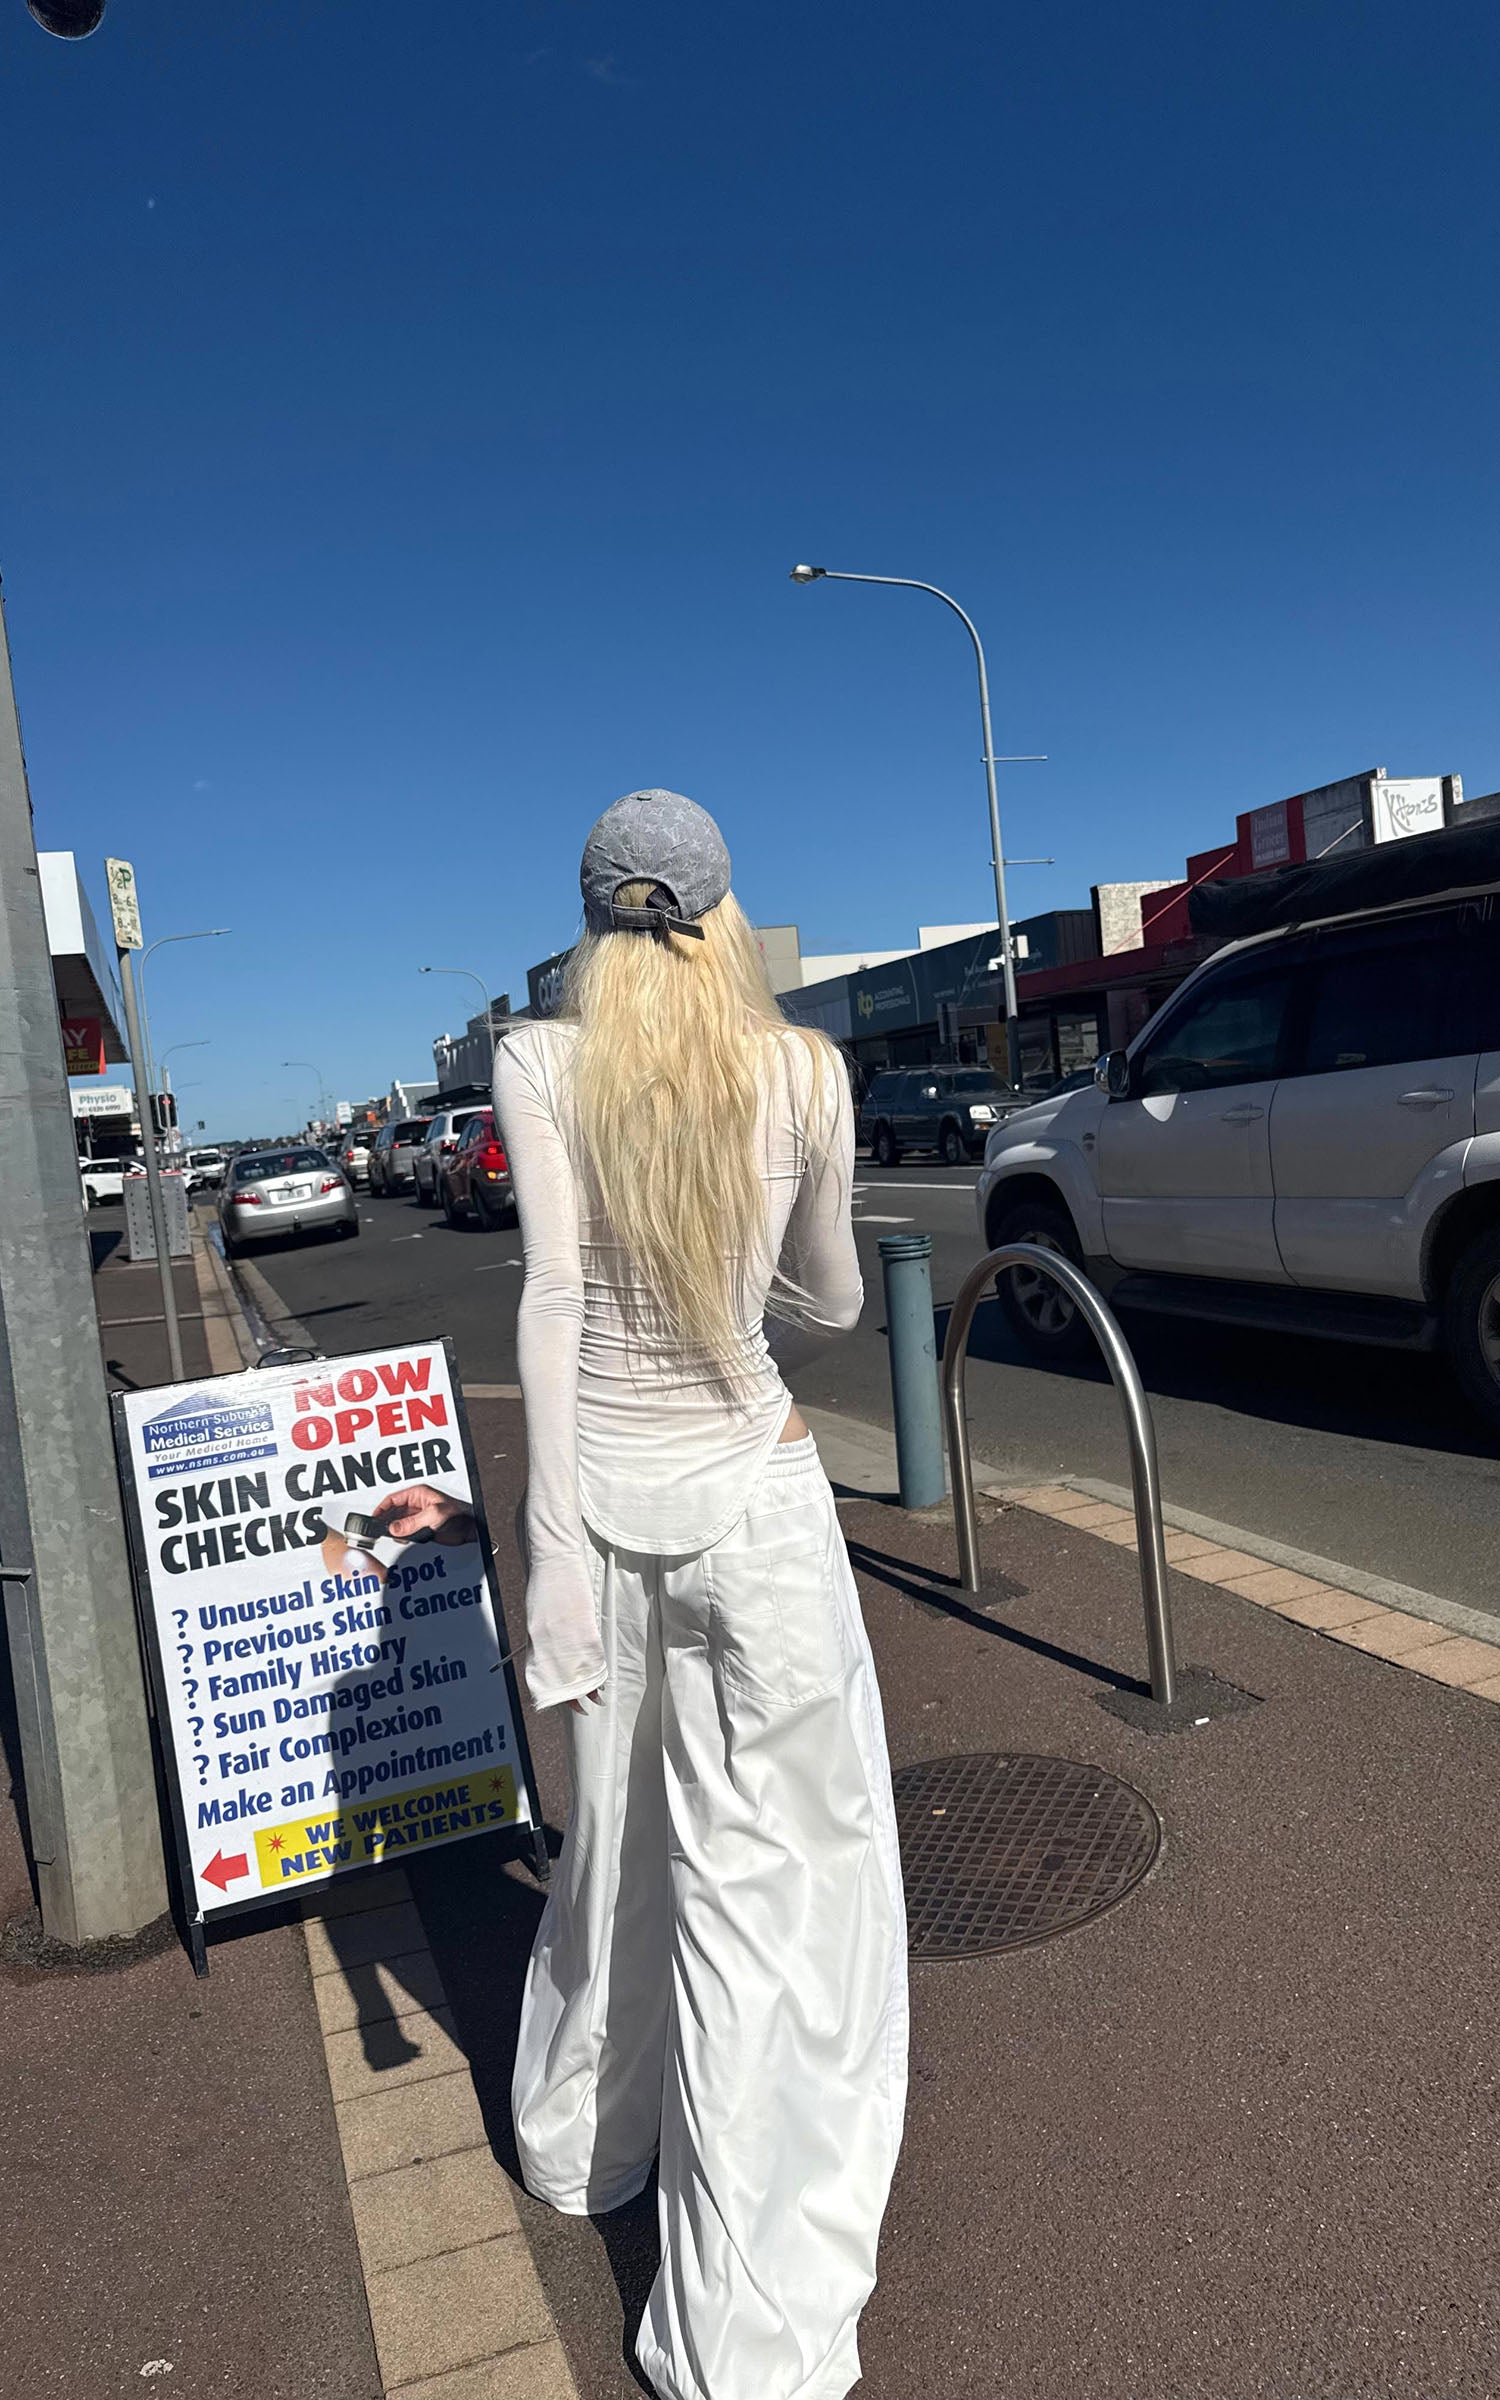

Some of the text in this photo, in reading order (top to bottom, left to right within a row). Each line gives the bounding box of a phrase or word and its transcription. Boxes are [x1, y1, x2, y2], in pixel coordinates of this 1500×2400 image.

[294, 1357, 432, 1412] NOW
[149, 1417, 209, 1436] Northern
[151, 1420, 270, 1451] Medical Service
[155, 1435, 268, 1463] Your Medical Home
[290, 1394, 449, 1451] OPEN
[154, 1439, 456, 1529] SKIN CANCER
[156, 1448, 265, 1475] www.nsms.com.au
[160, 1507, 329, 1575] CHECKS
[199, 1582, 313, 1632] Unusual
[320, 1564, 380, 1605] Skin
[387, 1554, 447, 1593] Spot
[203, 1618, 326, 1666] Previous
[333, 1597, 392, 1636] Skin
[399, 1584, 483, 1621] Cancer
[208, 1657, 302, 1702] Family
[311, 1635, 406, 1679] History
[215, 1709, 266, 1739] Sun
[274, 1669, 401, 1724] Damaged
[411, 1656, 467, 1691] Skin
[218, 1743, 271, 1779] Fair
[279, 1704, 443, 1763] Complexion
[198, 1725, 506, 1829] Make an Appointment!
[279, 1800, 506, 1878] NEW PATIENTS
[305, 1784, 472, 1846] WE WELCOME
